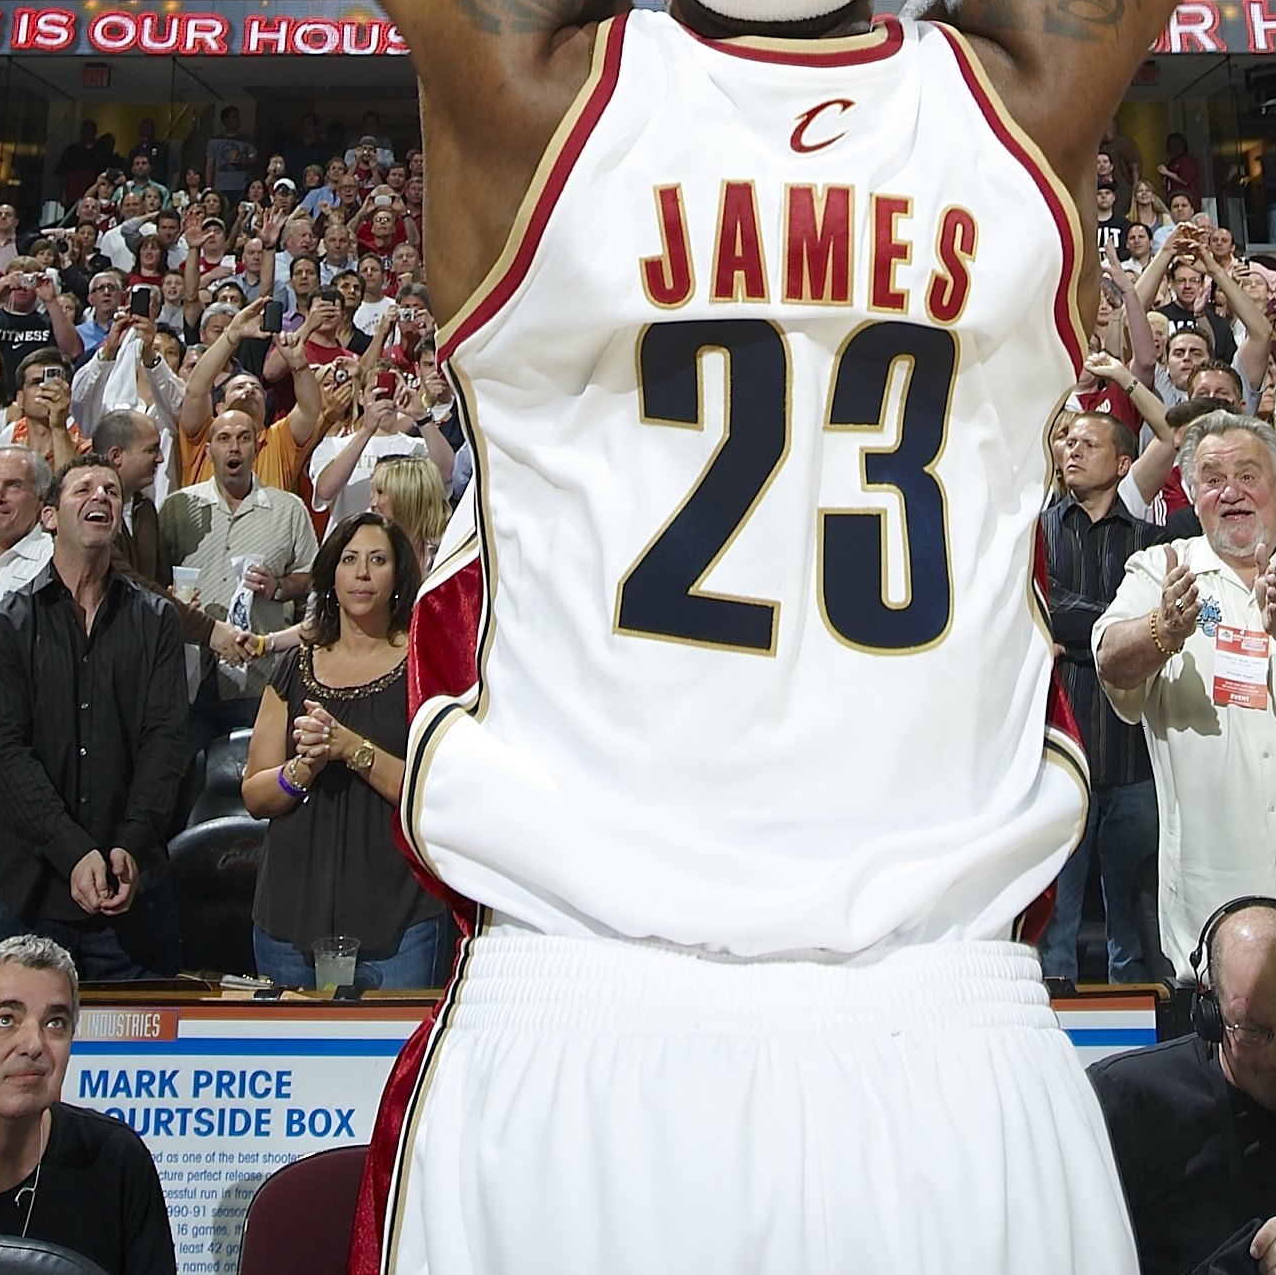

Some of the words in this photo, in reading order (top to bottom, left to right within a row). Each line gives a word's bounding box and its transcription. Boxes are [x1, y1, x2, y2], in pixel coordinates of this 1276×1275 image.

[17, 9, 71, 48] IS
[93, 13, 223, 52] OUR
[247, 16, 413, 56] HOUS
[639, 179, 979, 326] JAMES
[613, 317, 962, 658] 23
[86, 1013, 161, 1038] INDUSTRIES
[78, 1069, 180, 1100] MARK
[192, 1070, 293, 1099] PRICE
[101, 1108, 273, 1138] OURTSIDE
[284, 1108, 356, 1138] BOX
[166, 1154, 179, 1164] as
[182, 1154, 198, 1164] one
[205, 1151, 216, 1164] of
[219, 1151, 235, 1164] the
[238, 1151, 260, 1164] best
[187, 1169, 222, 1183] perfect
[225, 1170, 263, 1181] release
[200, 1190, 218, 1199] run
[222, 1187, 232, 1199] in
[177, 1224, 188, 1236] 16
[191, 1224, 230, 1238] games,
[179, 1241, 204, 1254] least
[207, 1242, 222, 1254] 42
[182, 1260, 220, 1273] named
